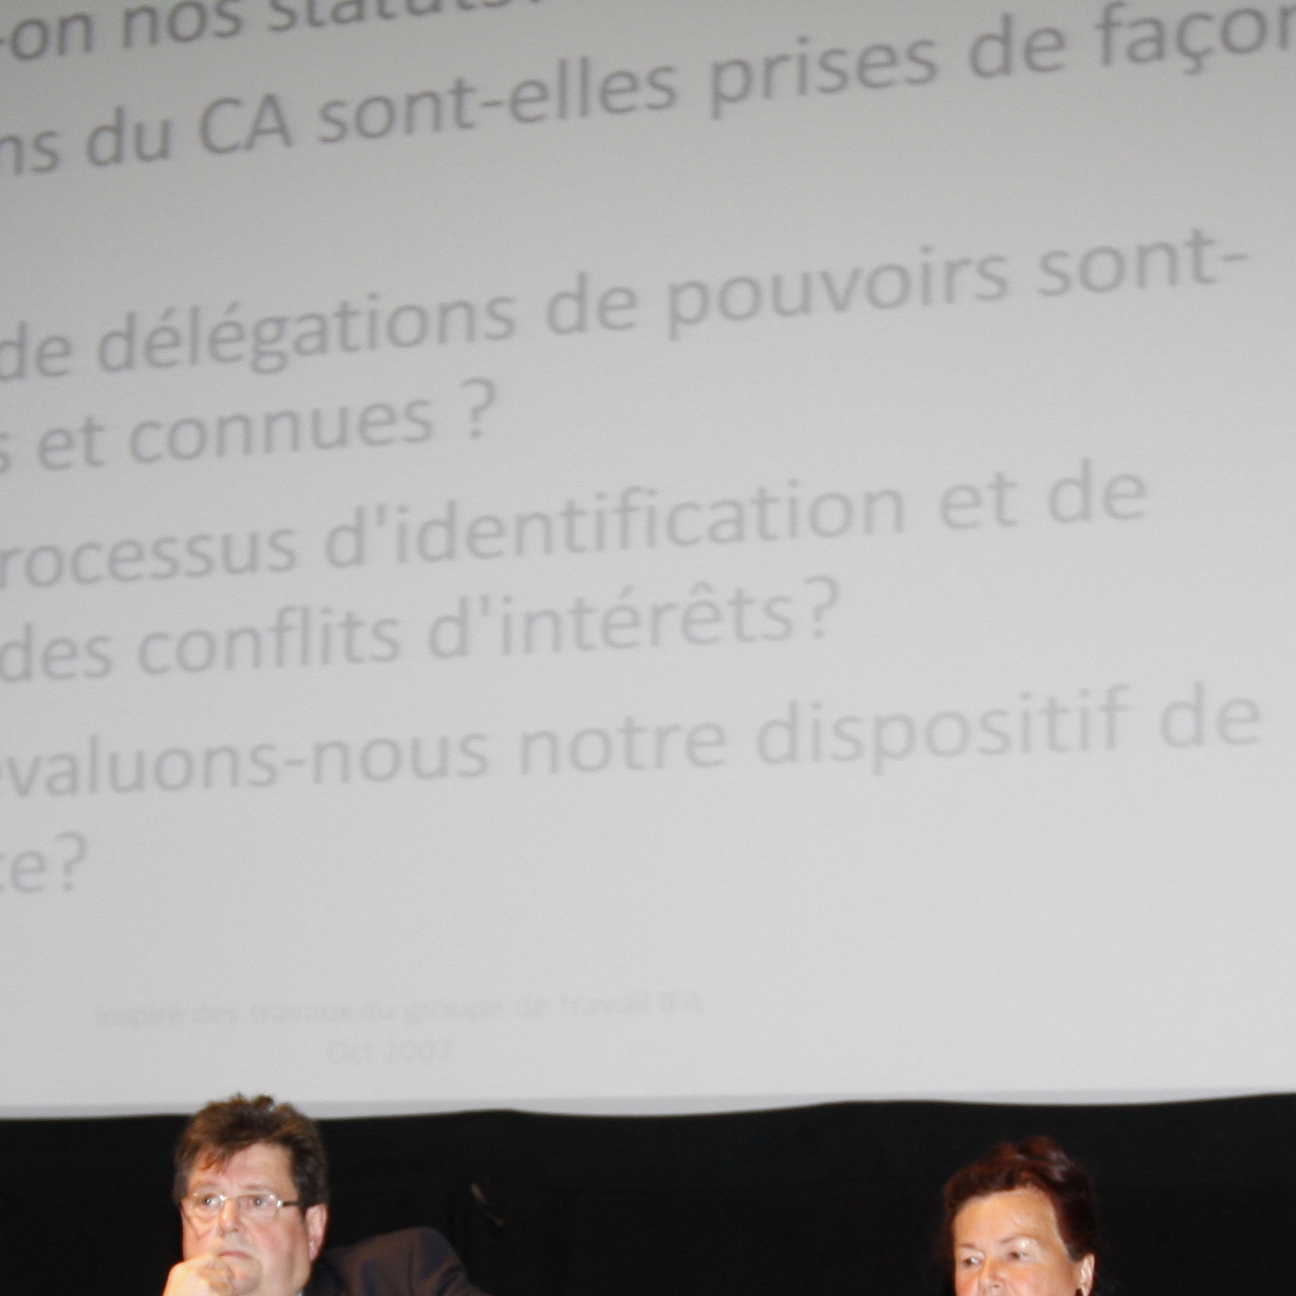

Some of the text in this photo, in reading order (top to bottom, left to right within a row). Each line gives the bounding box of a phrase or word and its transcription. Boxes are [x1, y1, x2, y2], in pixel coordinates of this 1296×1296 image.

[120, 0, 247, 50] nos
[83, 105, 175, 169] du
[196, 91, 296, 157] CA
[316, 54, 681, 146] sont-elles
[708, 34, 941, 122] prises
[966, 10, 1070, 81] de
[95, 291, 518, 376] délégations
[544, 270, 640, 337] de
[666, 244, 1011, 342] pouvoirs
[1037, 227, 1250, 298] sont-
[36, 417, 105, 472] et
[128, 398, 435, 465] connues
[462, 376, 499, 440] ?
[323, 485, 906, 570] d'identification
[938, 471, 1018, 531] et
[1046, 457, 1149, 525] de
[136, 604, 403, 676] conflits
[426, 575, 841, 660] d'intérêts?
[519, 716, 728, 775] notre
[755, 683, 1130, 776] dispositif
[1158, 681, 1262, 749] de
[192, 1001, 238, 1025] des
[249, 1003, 353, 1025] travaux
[359, 998, 397, 1022] du
[403, 999, 505, 1028] groupe
[513, 995, 550, 1018] de
[559, 991, 652, 1017] travail
[658, 990, 705, 1015] IFA
[326, 1038, 455, 1064] Oct 2007
